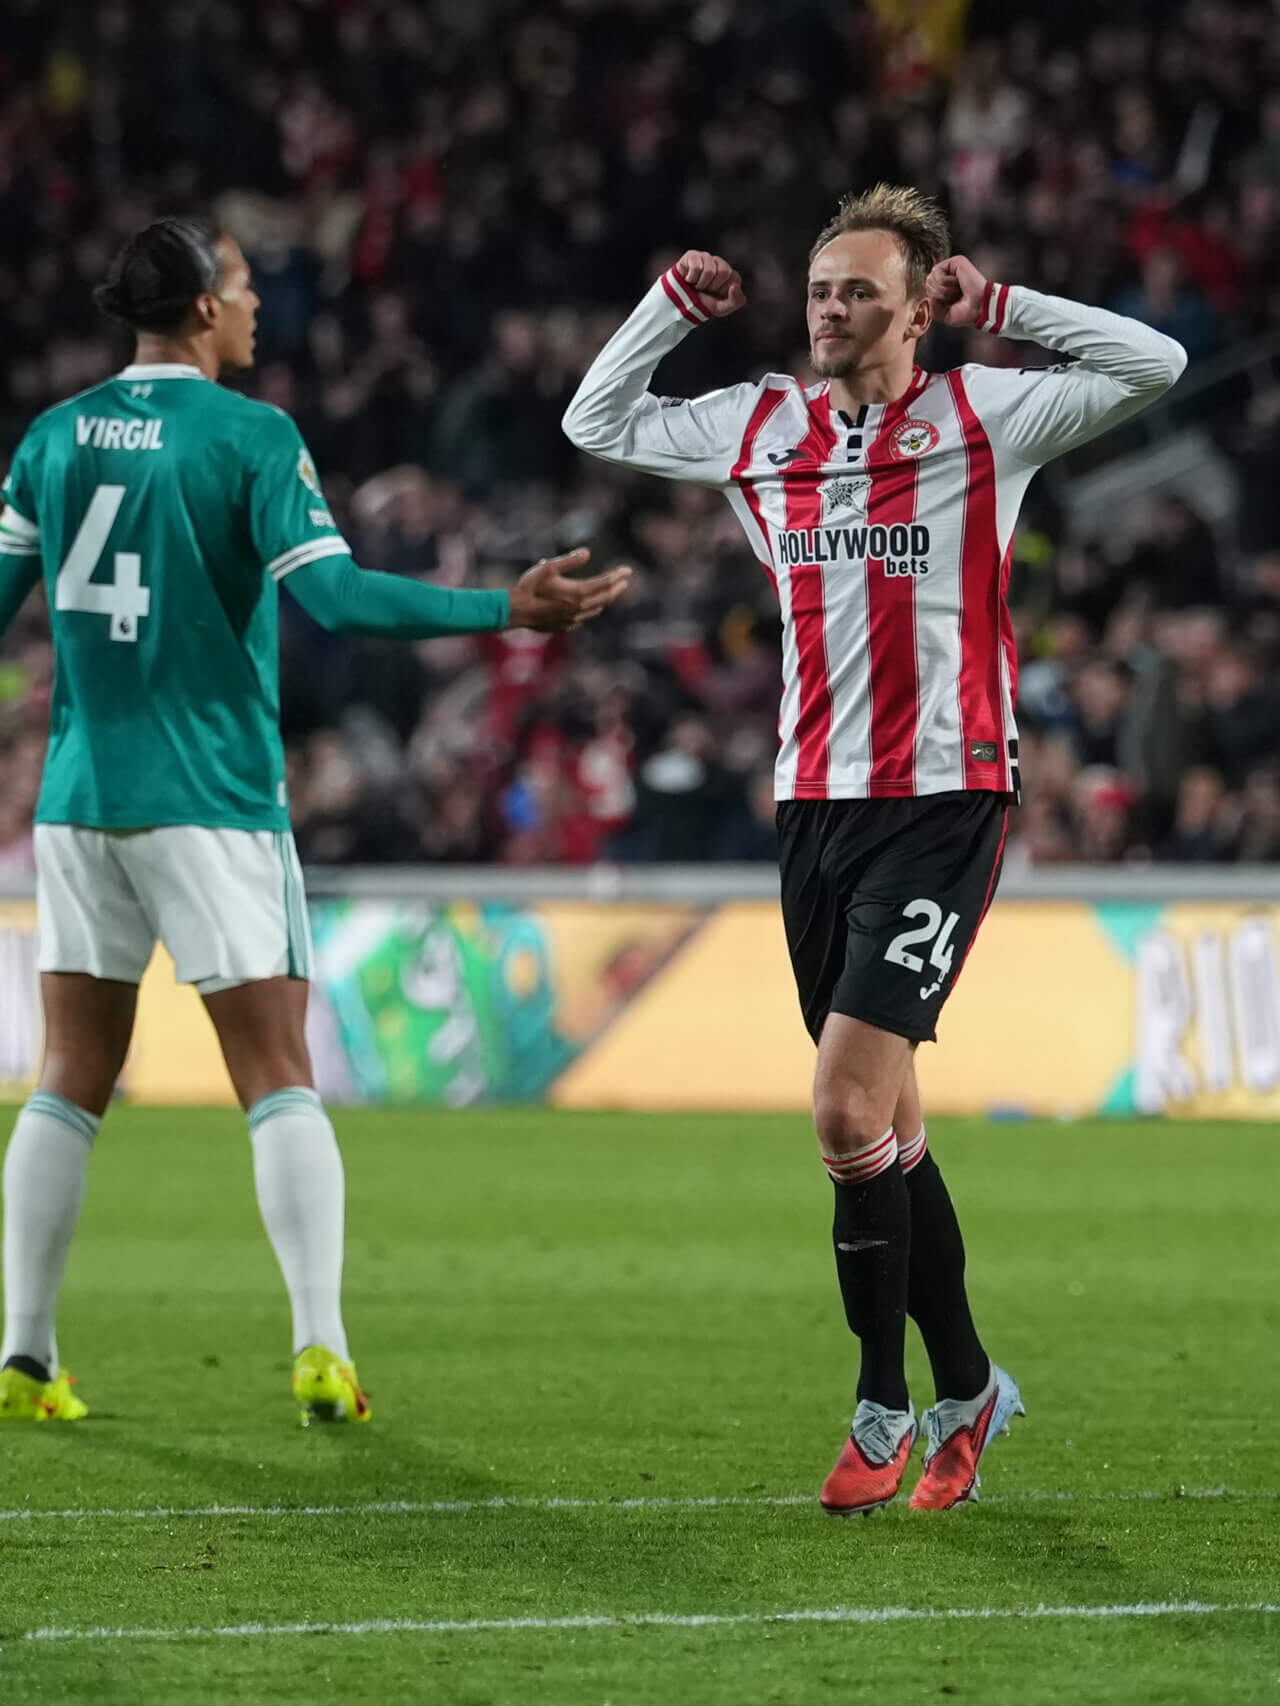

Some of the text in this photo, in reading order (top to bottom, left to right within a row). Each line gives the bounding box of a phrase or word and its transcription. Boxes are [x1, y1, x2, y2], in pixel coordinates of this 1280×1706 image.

[75, 415, 164, 450] VIRGIL
[55, 484, 150, 642] 4
[778, 524, 931, 564] HOLLYWOOD
[886, 558, 929, 575] bets
[884, 898, 960, 983] 24
